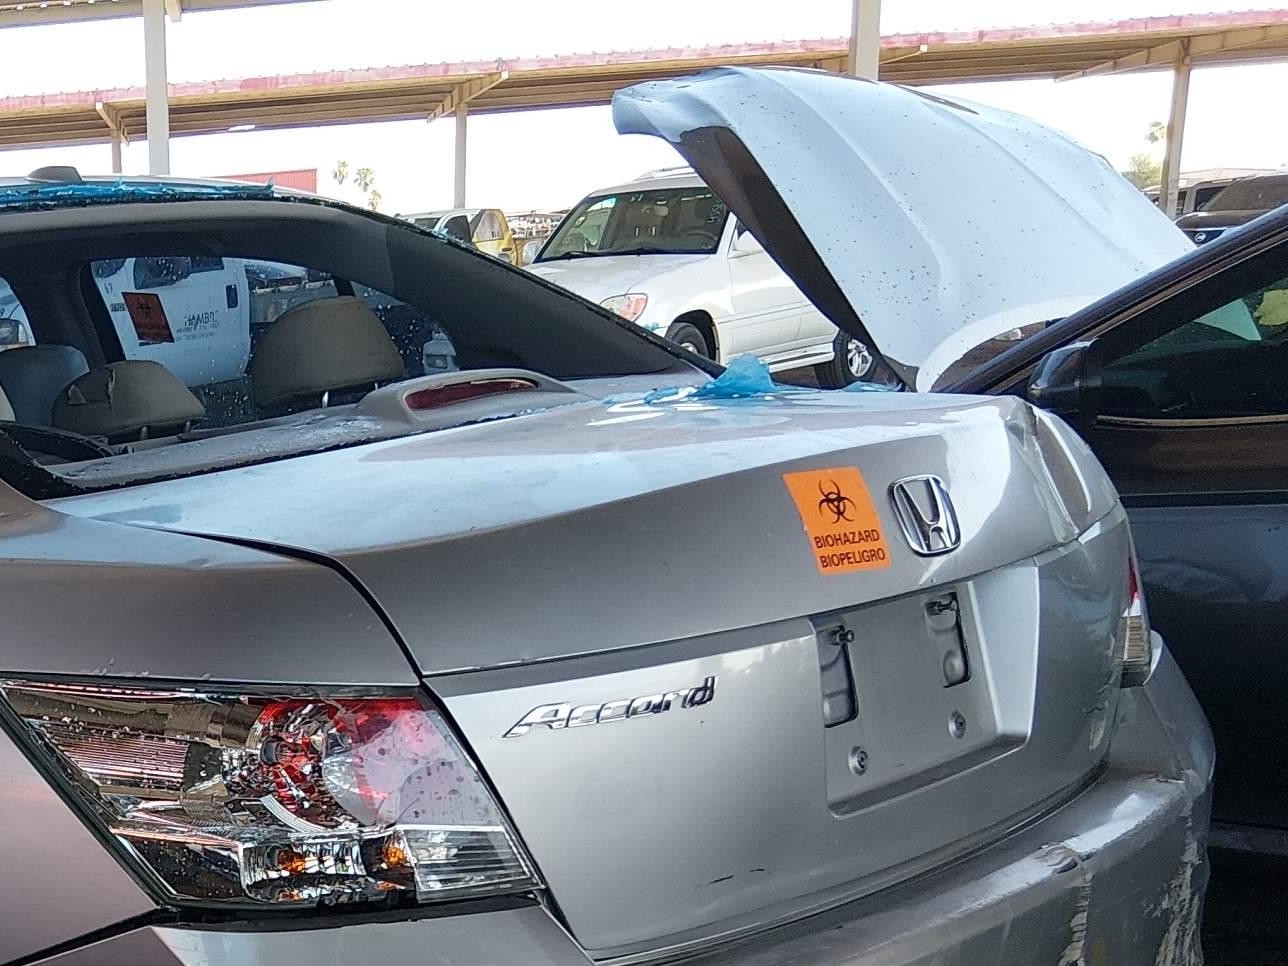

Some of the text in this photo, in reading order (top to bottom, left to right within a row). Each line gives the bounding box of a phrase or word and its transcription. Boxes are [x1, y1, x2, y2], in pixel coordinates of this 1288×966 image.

[814, 529, 880, 549] BIOHAZARD
[819, 548, 886, 568] BIOPELIGRO
[502, 676, 719, 738] Accord
